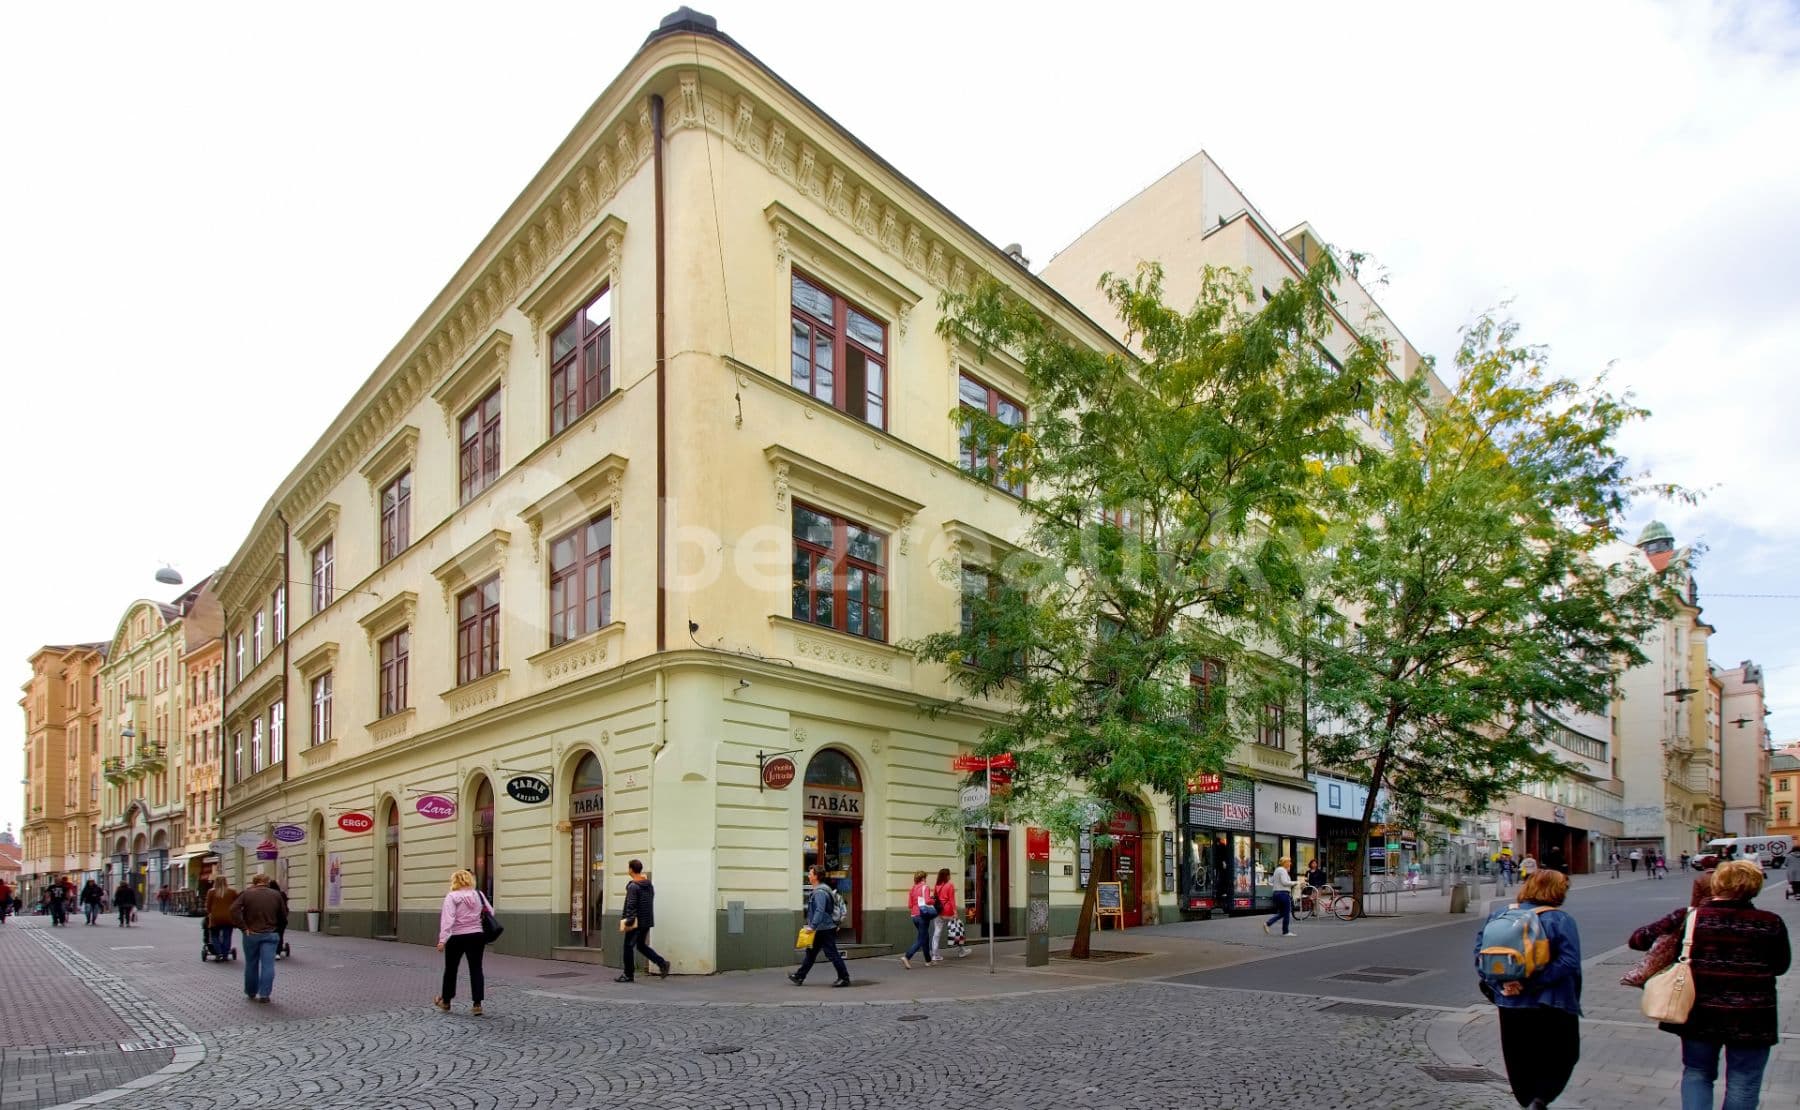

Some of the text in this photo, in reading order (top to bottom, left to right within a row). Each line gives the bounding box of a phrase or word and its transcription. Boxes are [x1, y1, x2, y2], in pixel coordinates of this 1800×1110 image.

[511, 779, 546, 794] TABÁK
[420, 802, 452, 816] Lara
[809, 794, 860, 813] TABÁK
[1223, 802, 1250, 821] JEANS
[342, 818, 369, 828] ERGO
